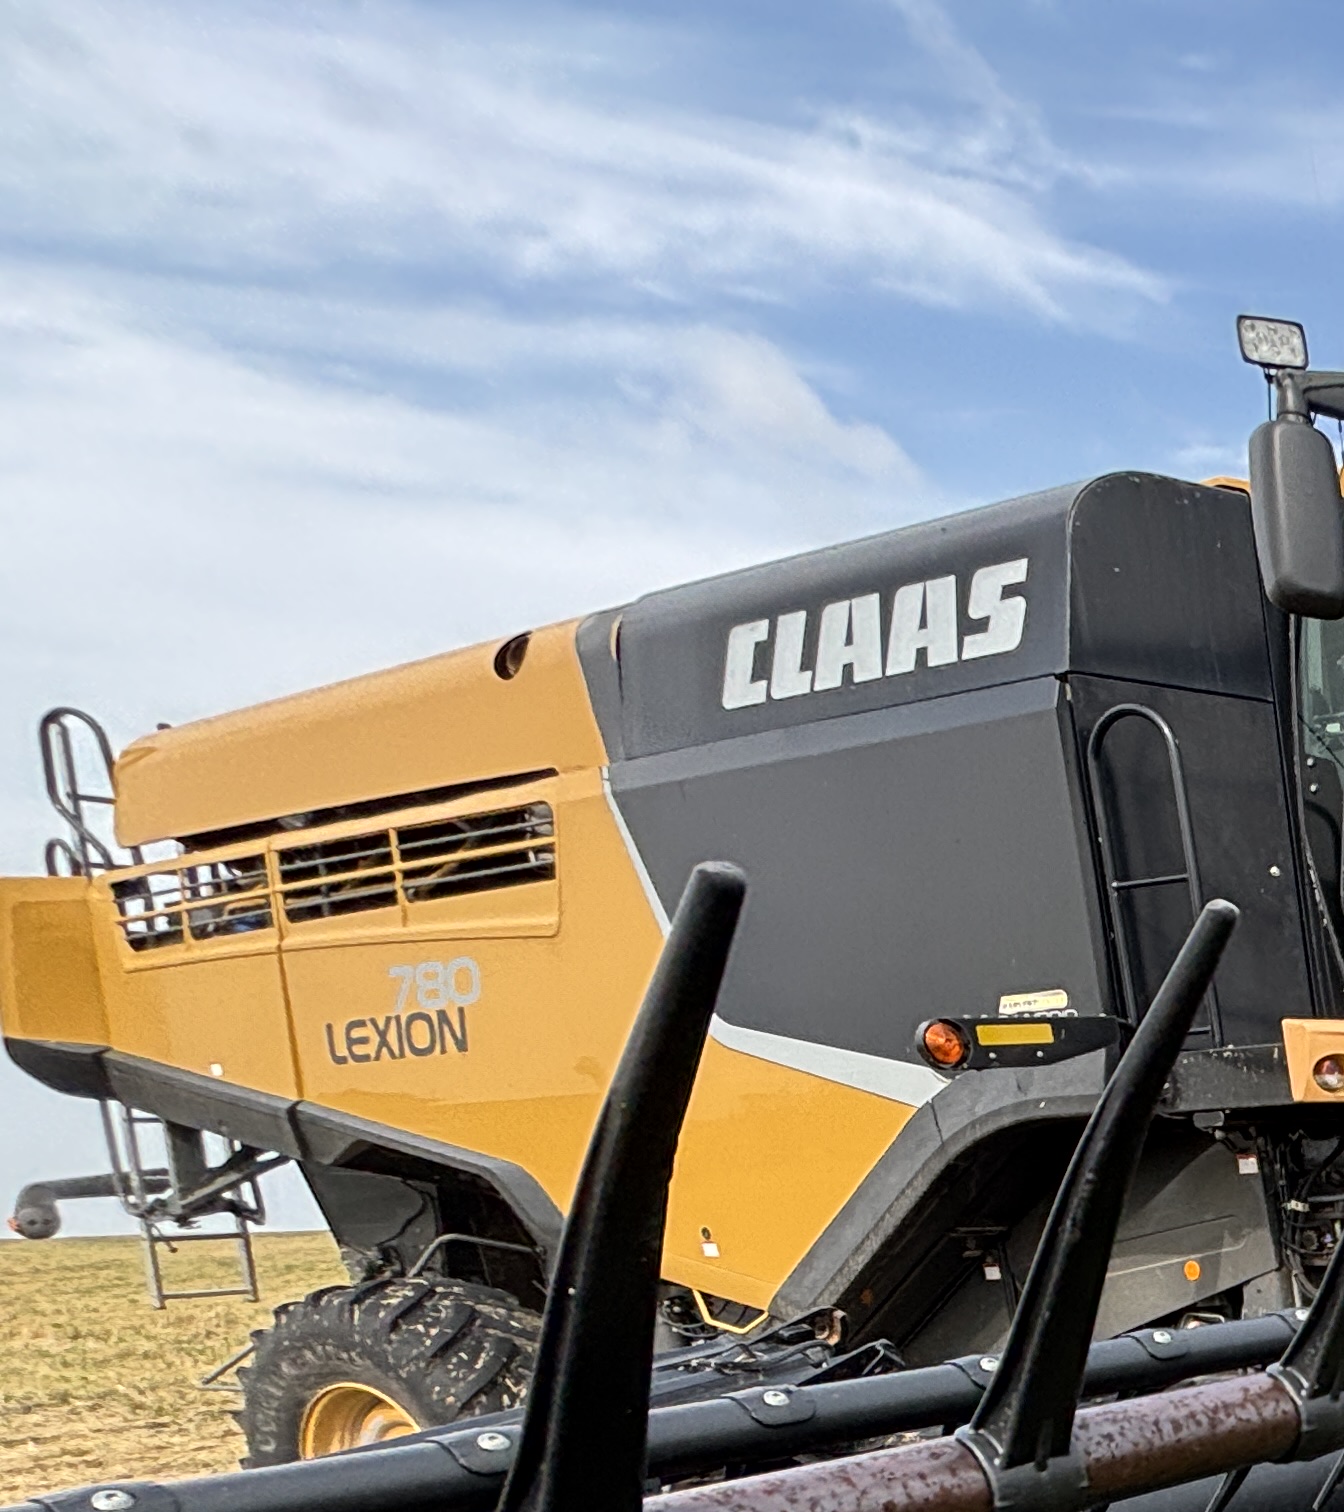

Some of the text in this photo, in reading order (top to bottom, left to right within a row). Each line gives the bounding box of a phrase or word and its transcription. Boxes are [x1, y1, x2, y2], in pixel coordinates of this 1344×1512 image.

[722, 558, 1029, 711] CLAAS
[388, 955, 481, 1015] 780
[325, 1006, 469, 1065] LEXION
